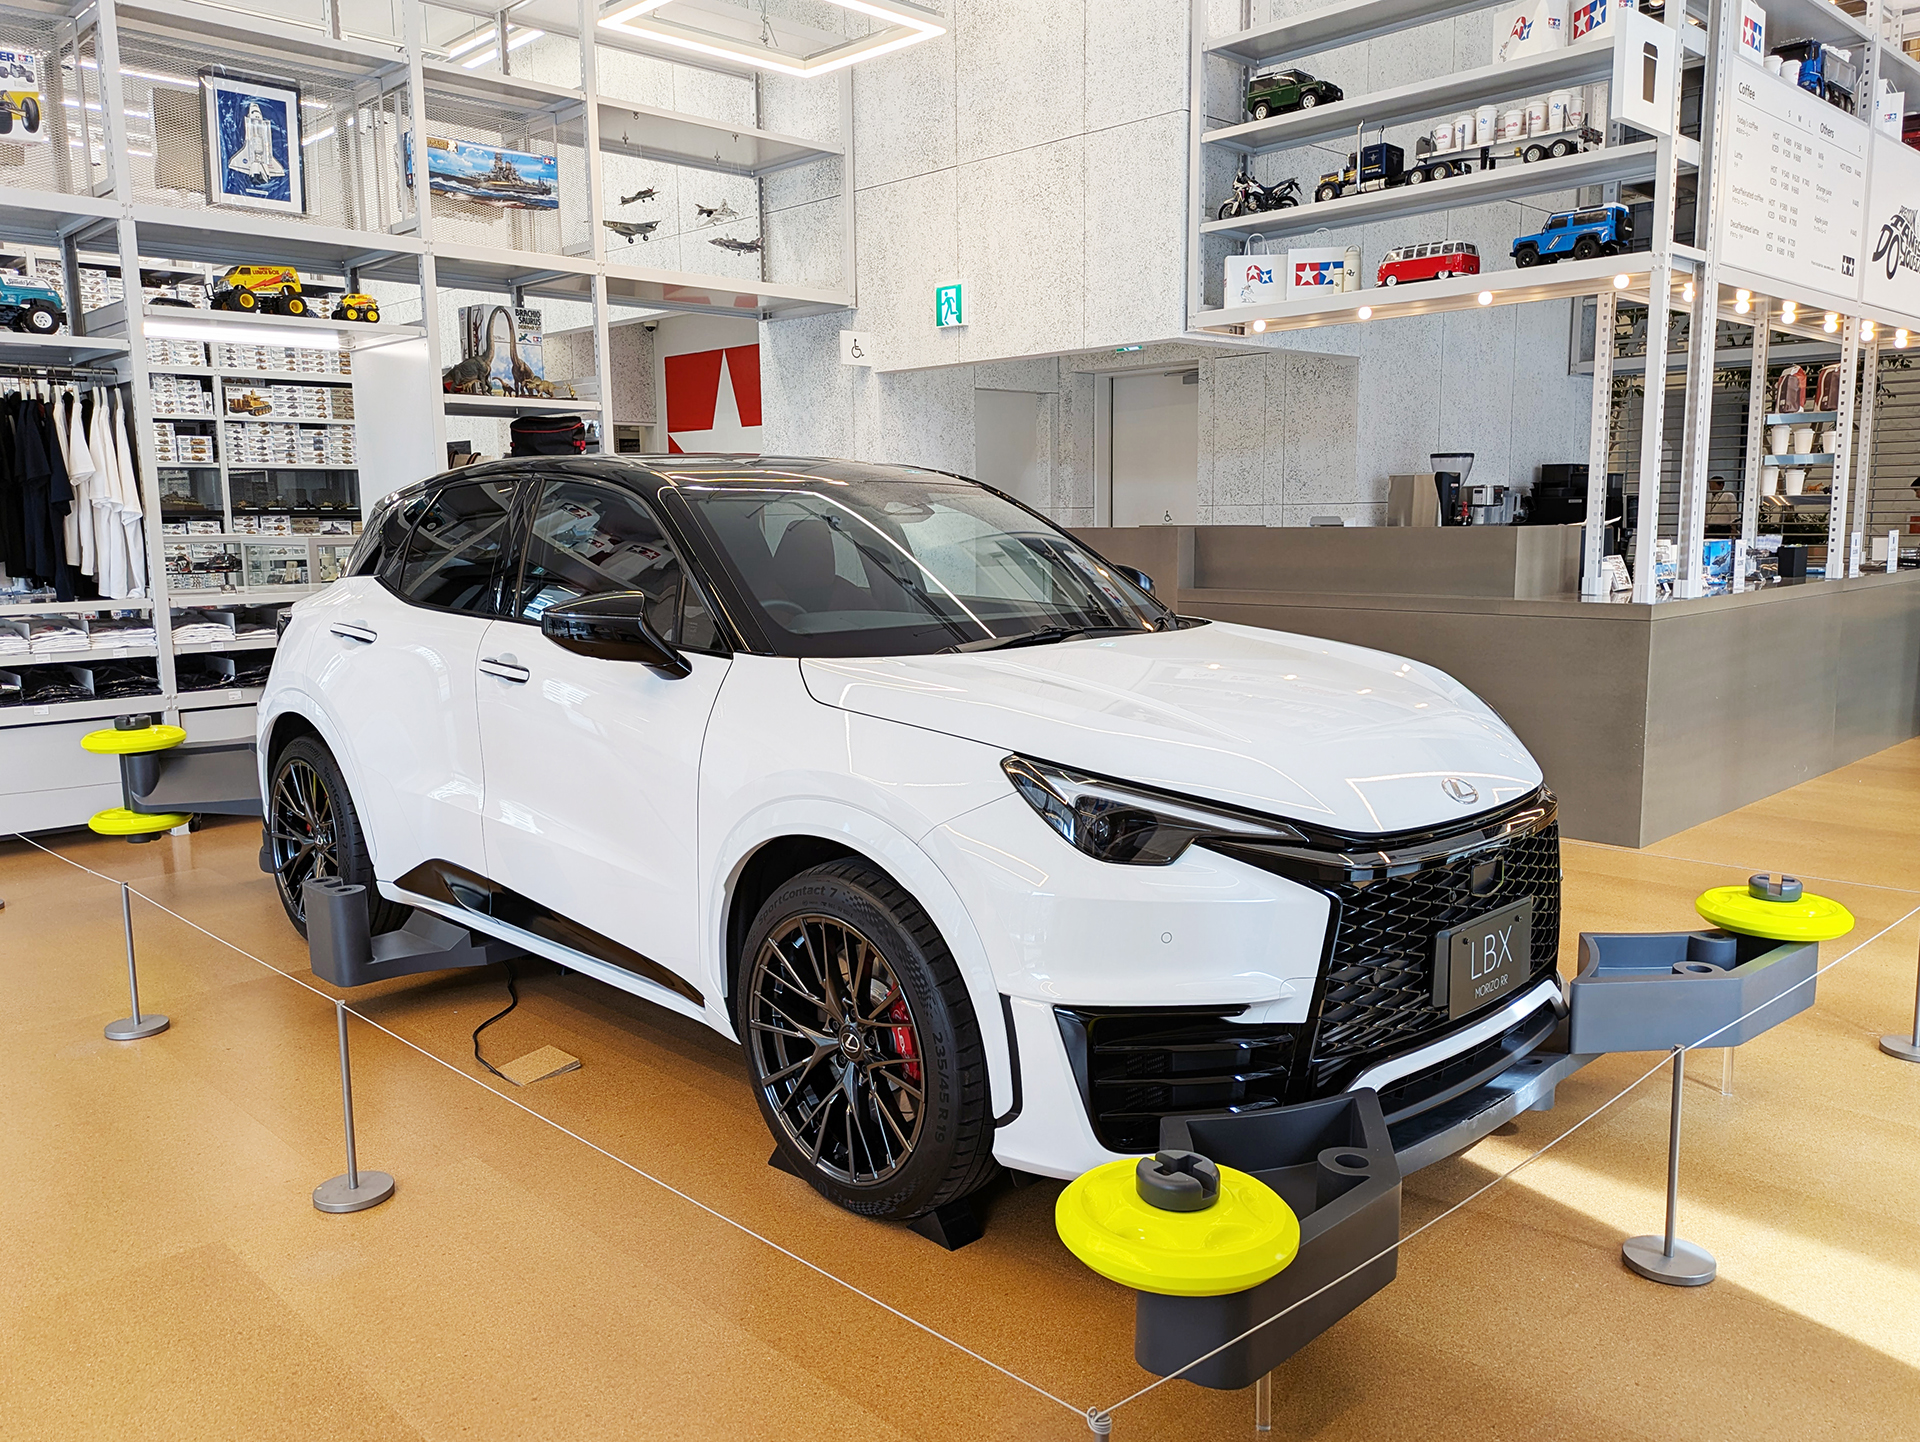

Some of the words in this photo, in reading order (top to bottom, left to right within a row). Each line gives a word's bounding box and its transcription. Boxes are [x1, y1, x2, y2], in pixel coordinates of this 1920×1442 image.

[1738, 82, 1756, 100] Coffee
[1820, 122, 1835, 139] Others
[828, 887, 838, 898] 7
[1471, 925, 1513, 980] LBX
[1474, 977, 1500, 999] MORIZO
[1500, 973, 1509, 986] RR
[931, 1031, 950, 1104] 235/45
[937, 1111, 949, 1121] R
[934, 1124, 946, 1144] 19
